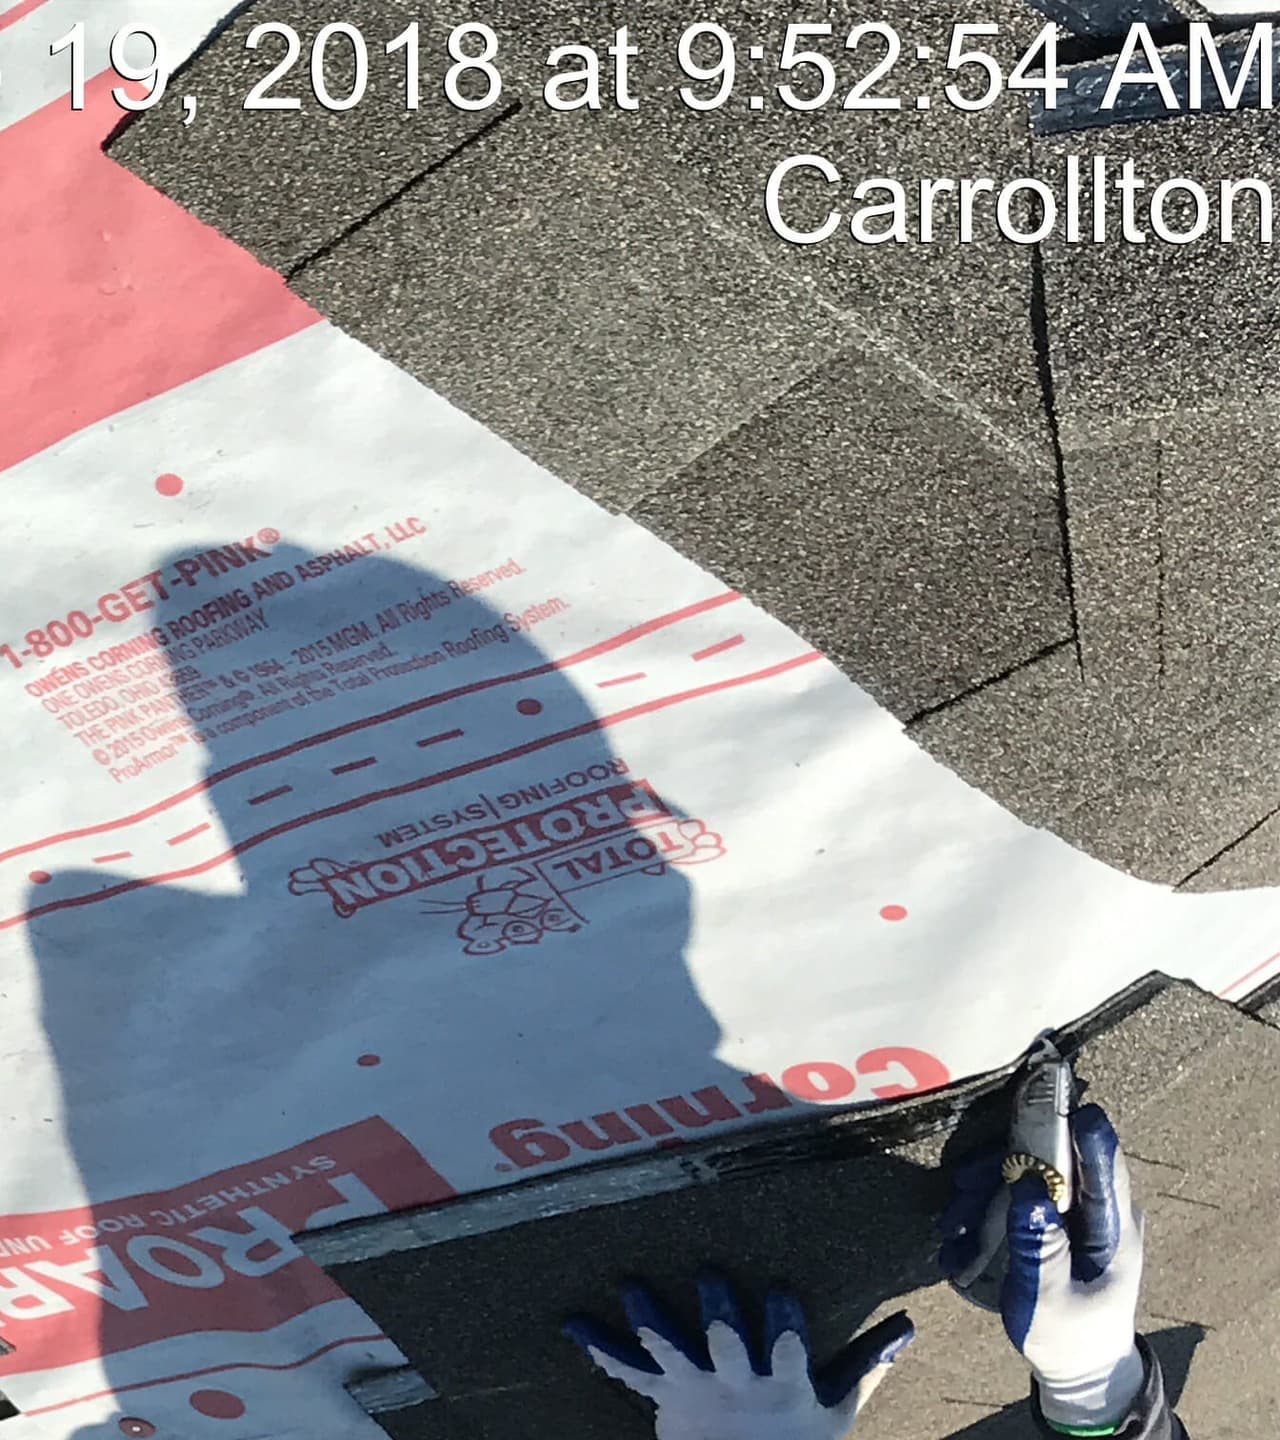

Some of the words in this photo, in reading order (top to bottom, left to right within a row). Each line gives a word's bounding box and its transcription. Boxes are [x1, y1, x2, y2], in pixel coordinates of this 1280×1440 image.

[23, 660, 90, 698] OWENS
[87, 627, 168, 672] CORNING
[167, 589, 250, 639] ROOFING
[242, 570, 295, 602] AND
[295, 529, 389, 580] ASPHALT,
[387, 515, 426, 543] LLC
[40, 689, 81, 714] ONE
[72, 667, 131, 700] OWENS
[126, 640, 197, 681] CORNING
[193, 609, 271, 654] PARKWAY
[73, 724, 108, 747] THE
[105, 706, 152, 734] PINK
[291, 641, 333, 661] 2015
[375, 608, 400, 631] All
[398, 588, 453, 625] Rights
[448, 555, 526, 597] Reserved.
[118, 679, 161, 705] OHIO
[214, 699, 296, 736] component
[289, 693, 311, 704] of
[304, 684, 335, 700] the
[329, 672, 373, 689] Total
[369, 649, 447, 679] Protection
[444, 620, 508, 660] Roofing
[108, 733, 146, 759] 2015
[143, 715, 193, 742] Owens
[276, 667, 326, 690] Rights
[377, 802, 486, 849] SYSTEM
[497, 756, 629, 814] ROOFING
[323, 782, 658, 910] PROTECTION
[551, 827, 684, 886] TOTAL
[54, 1212, 145, 1244] ROOF
[151, 1152, 334, 1227] SYNTHETIC
